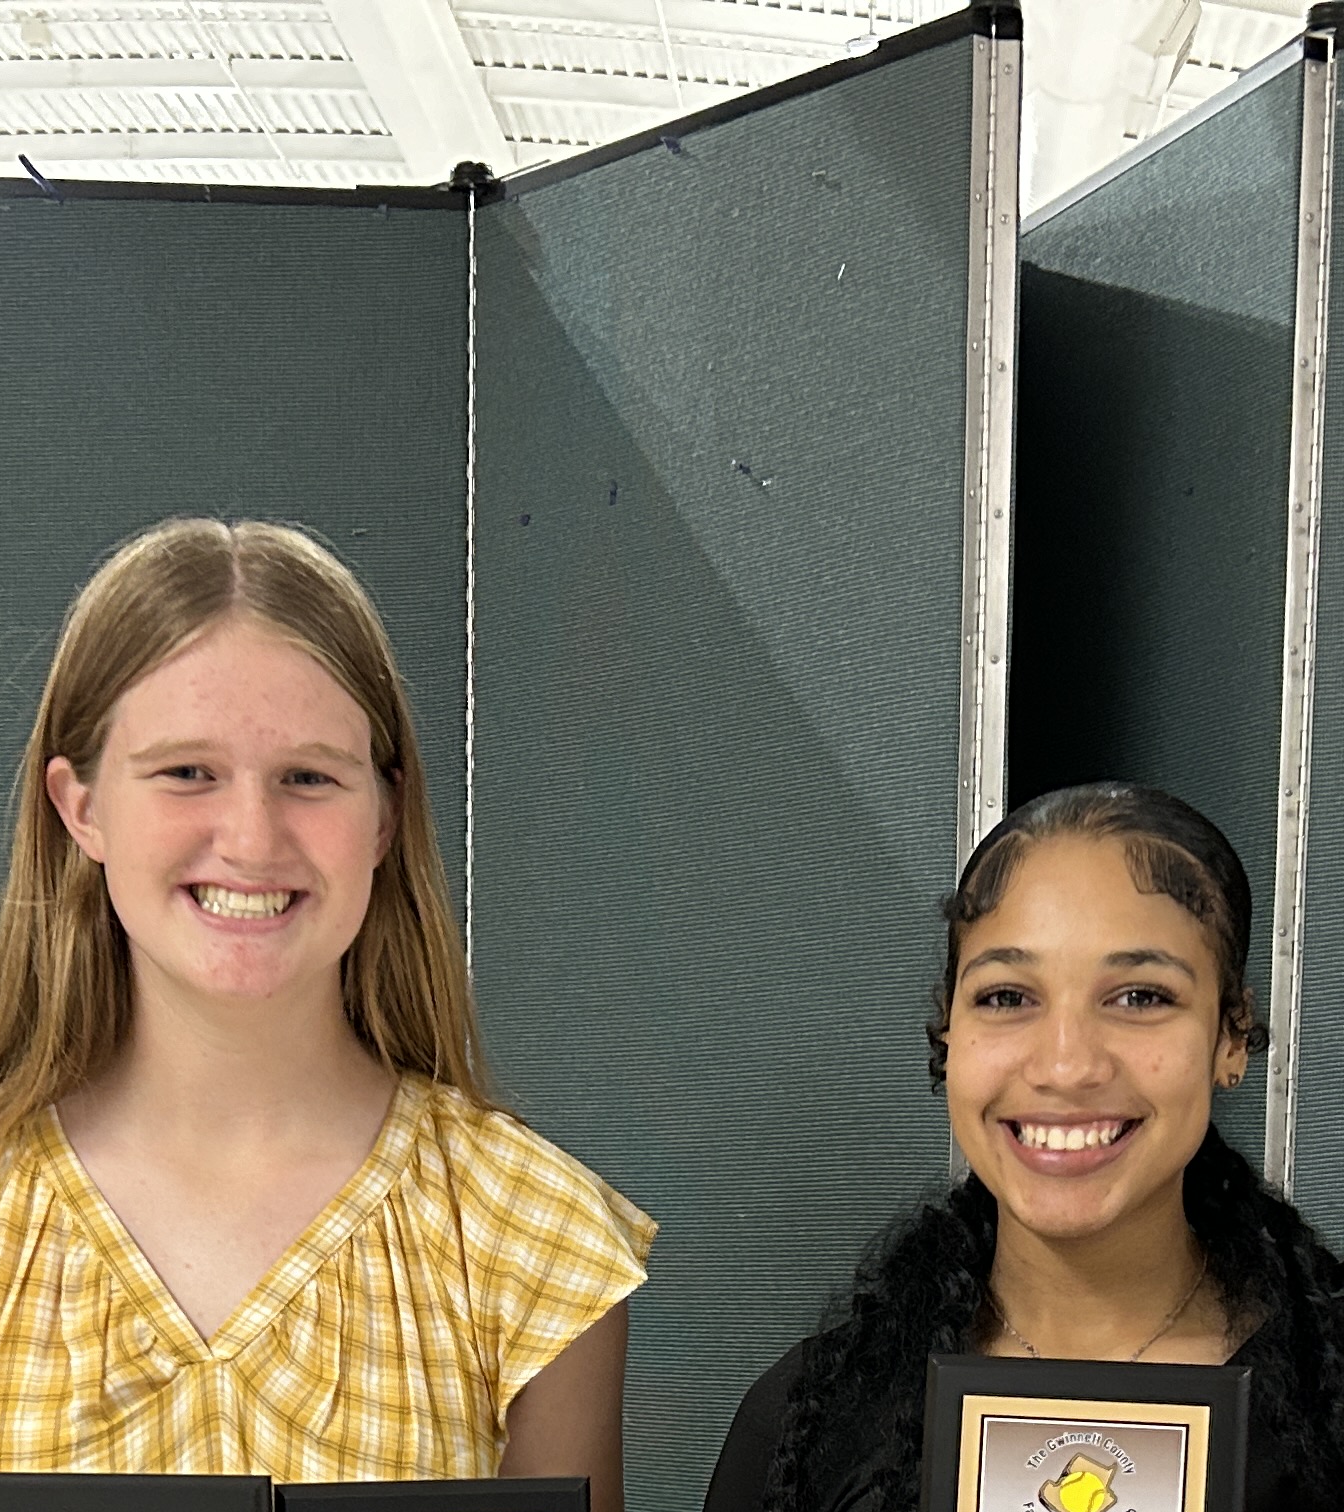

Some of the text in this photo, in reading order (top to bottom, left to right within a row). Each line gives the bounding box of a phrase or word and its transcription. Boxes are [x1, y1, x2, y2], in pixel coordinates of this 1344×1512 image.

[1027, 1434, 1134, 1474] The Gwinnett County
